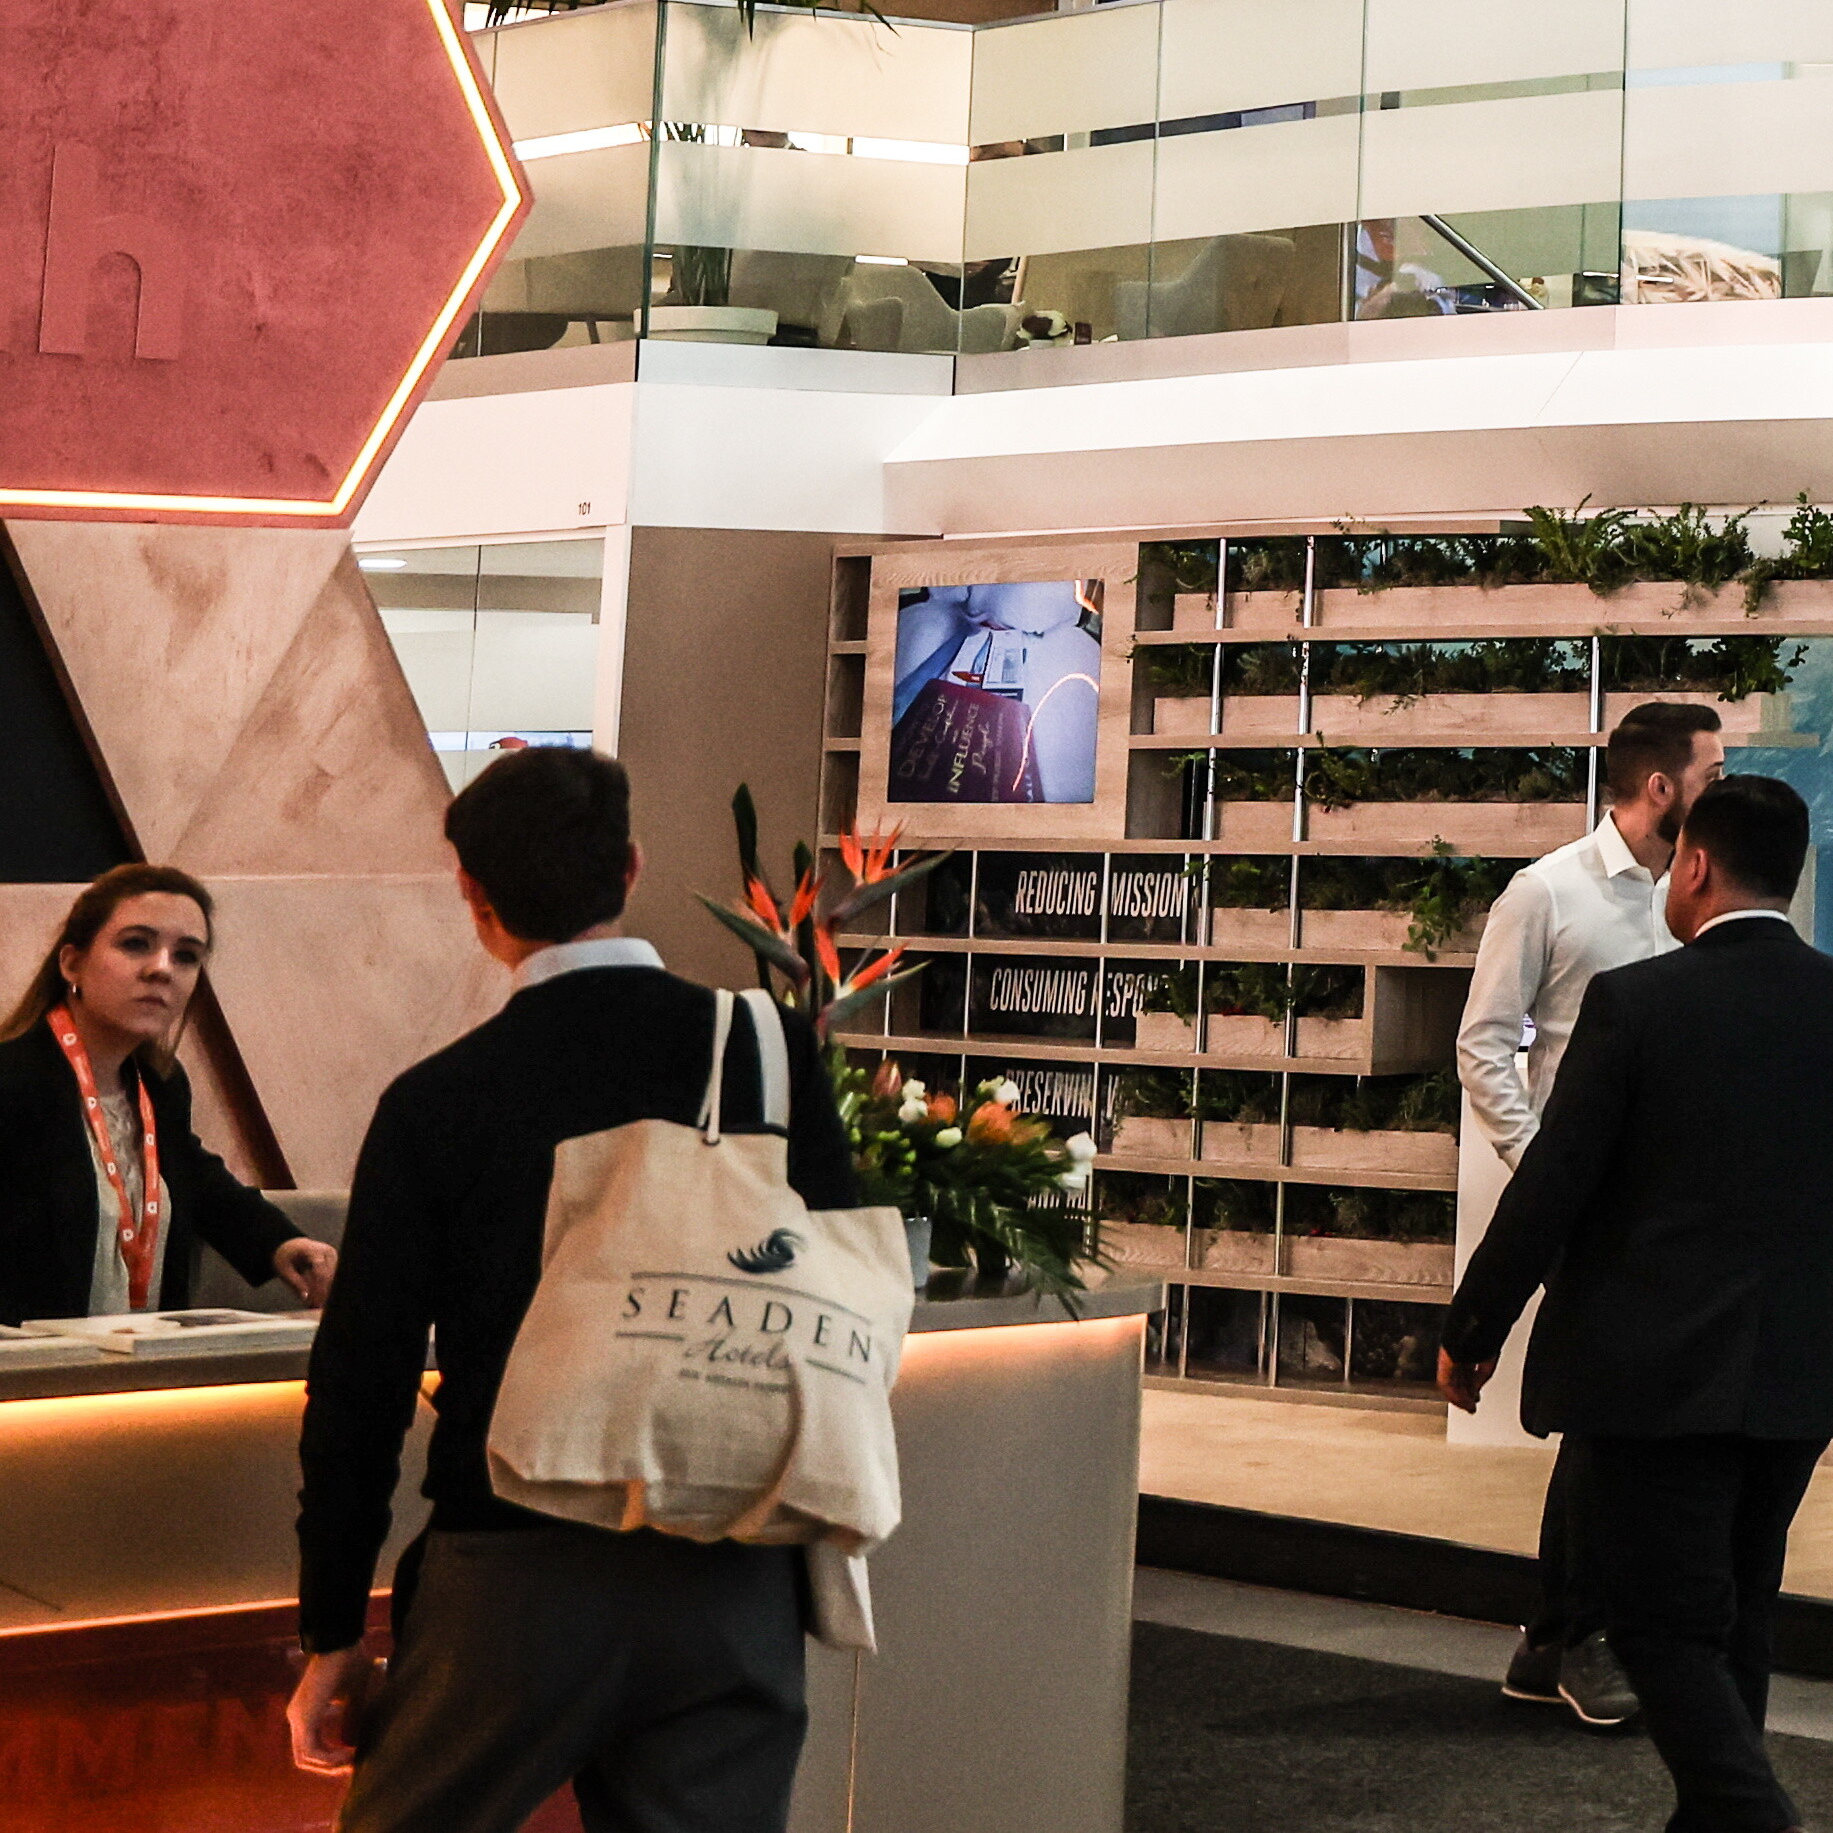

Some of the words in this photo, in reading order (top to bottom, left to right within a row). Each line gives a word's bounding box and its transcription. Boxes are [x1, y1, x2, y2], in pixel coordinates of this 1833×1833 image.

[578, 501, 591, 516] 101
[1015, 870, 1098, 916] REDUCING
[1099, 871, 1197, 918] MISSION
[989, 968, 1088, 1016] CONSUMING
[622, 1286, 875, 1364] SEADEN
